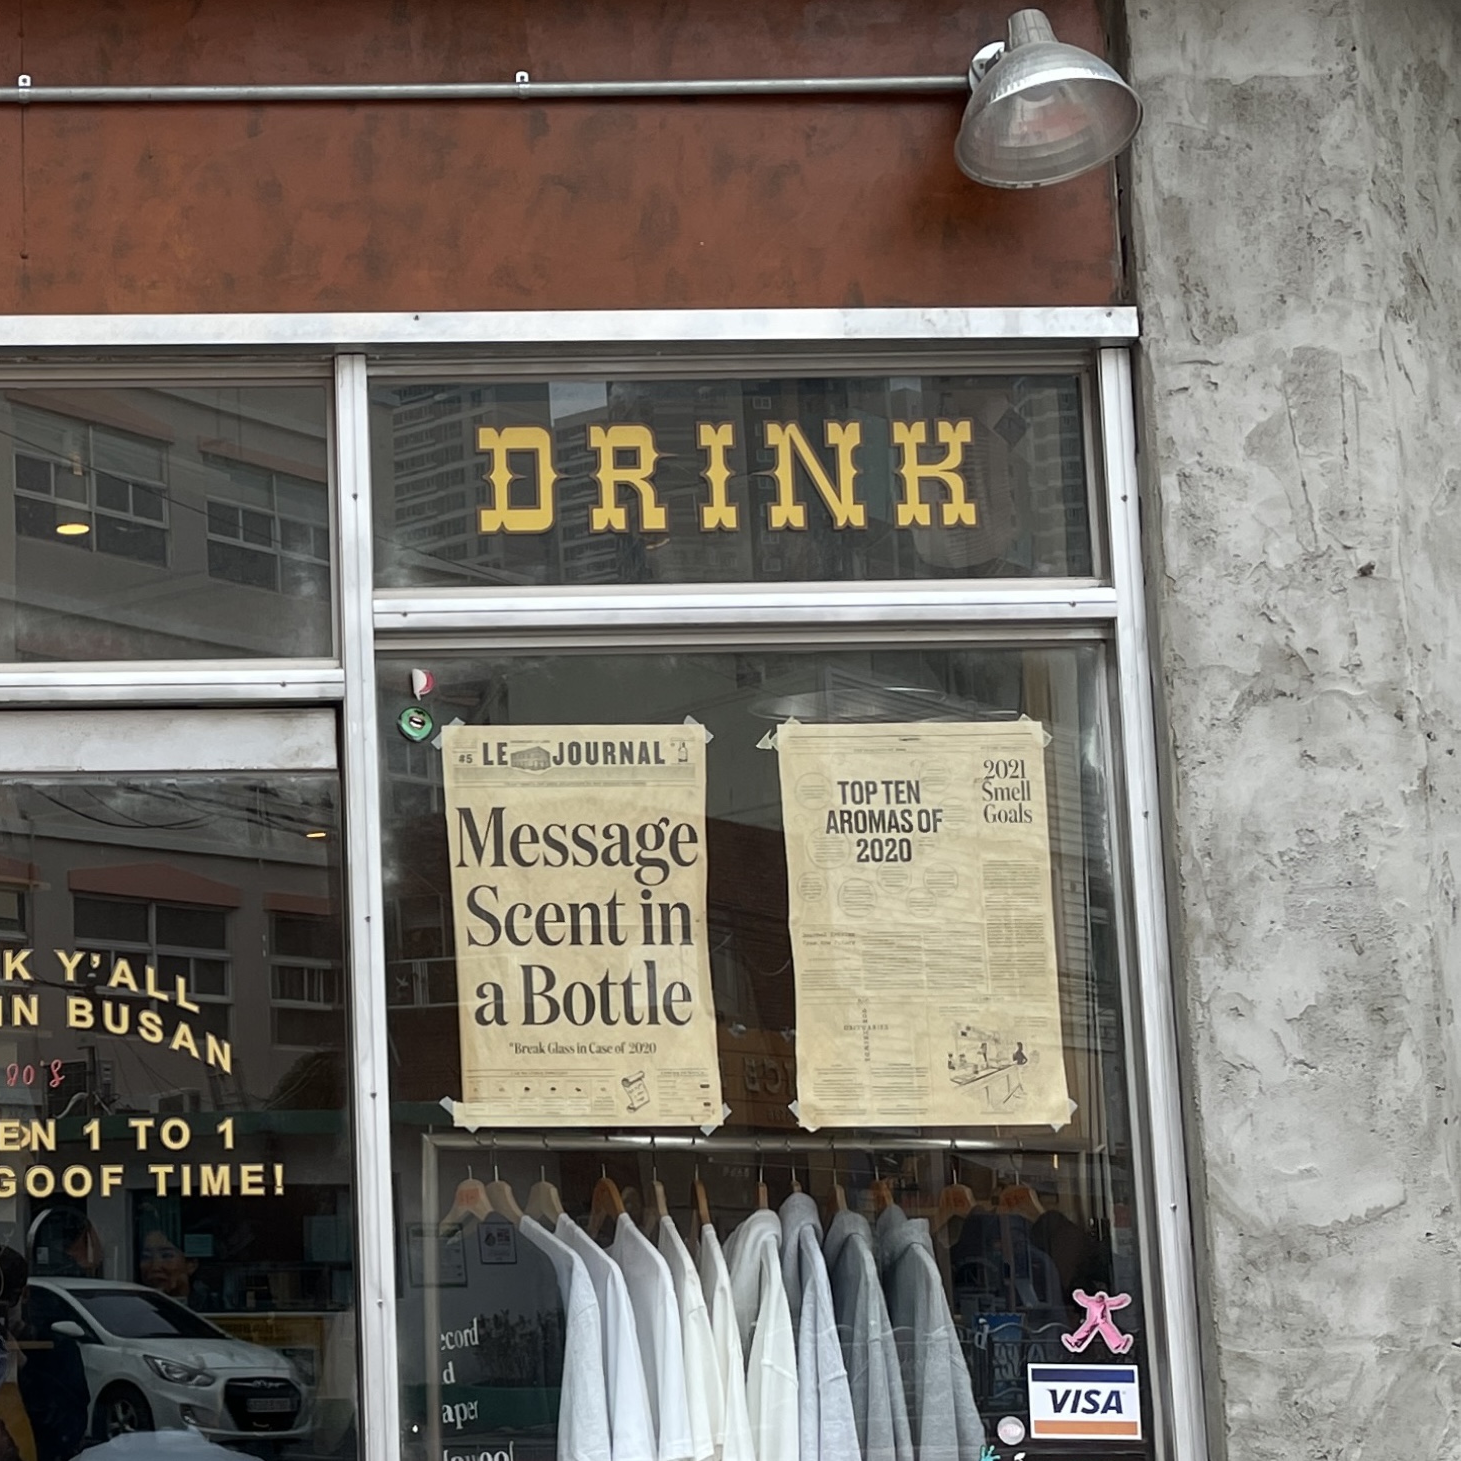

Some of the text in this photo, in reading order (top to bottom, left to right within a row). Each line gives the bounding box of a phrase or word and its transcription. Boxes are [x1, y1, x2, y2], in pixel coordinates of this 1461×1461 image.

[476, 420, 974, 534] DRINK
[482, 740, 666, 766] LE JOURNAL
[983, 759, 1027, 779] 2021
[837, 779, 921, 805] TOP TEN
[982, 780, 1032, 802] Smell
[825, 808, 943, 834] AROMAS OF
[983, 803, 1033, 824] Goals
[455, 806, 699, 887] Message
[855, 837, 913, 863] 2020
[466, 884, 695, 947] Scent in
[53, 949, 201, 1015] Y'ALL
[474, 959, 693, 1027] a Bottle
[66, 995, 232, 1076] BUSAN
[547, 1041, 575, 1055] Glass
[576, 1041, 588, 1055] in
[589, 1041, 614, 1055] Case
[615, 1041, 627, 1055] of
[628, 1041, 657, 1055] 2020
[82, 1117, 101, 1151] 1
[128, 1116, 191, 1151] TO
[216, 1116, 235, 1150] 1
[147, 1162, 284, 1198] TIME!
[1046, 1389, 1124, 1415] VISA
